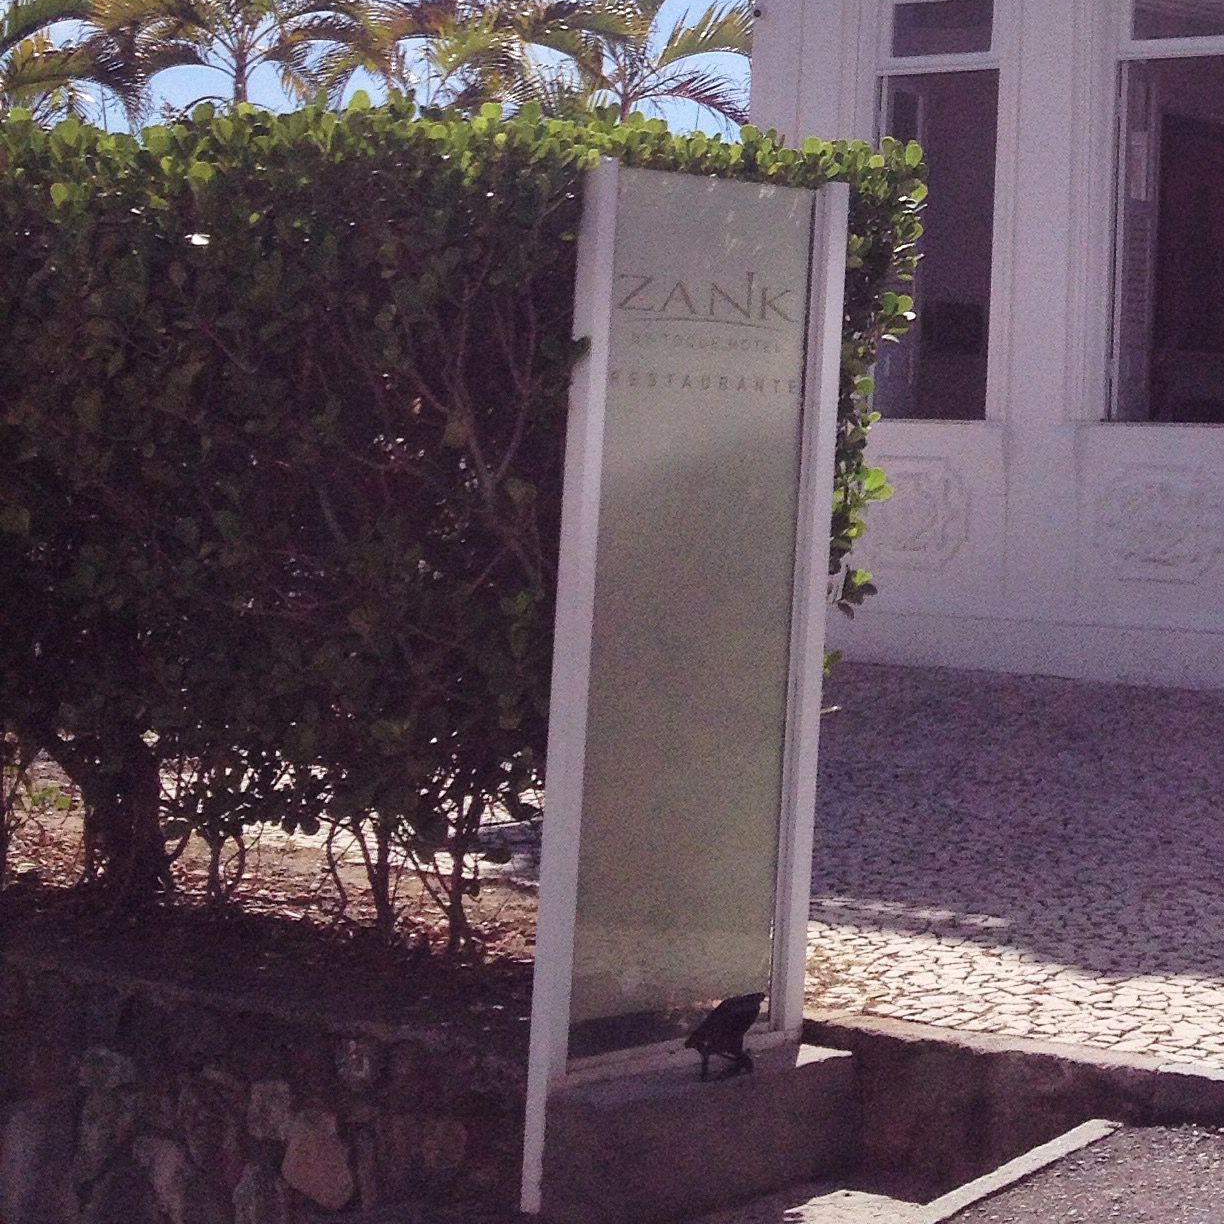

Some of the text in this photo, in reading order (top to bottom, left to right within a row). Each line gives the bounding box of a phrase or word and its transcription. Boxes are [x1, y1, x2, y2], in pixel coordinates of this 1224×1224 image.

[615, 271, 798, 323] ZANK
[727, 337, 783, 354] HOTEL
[609, 370, 798, 395] RESTAURANTE
